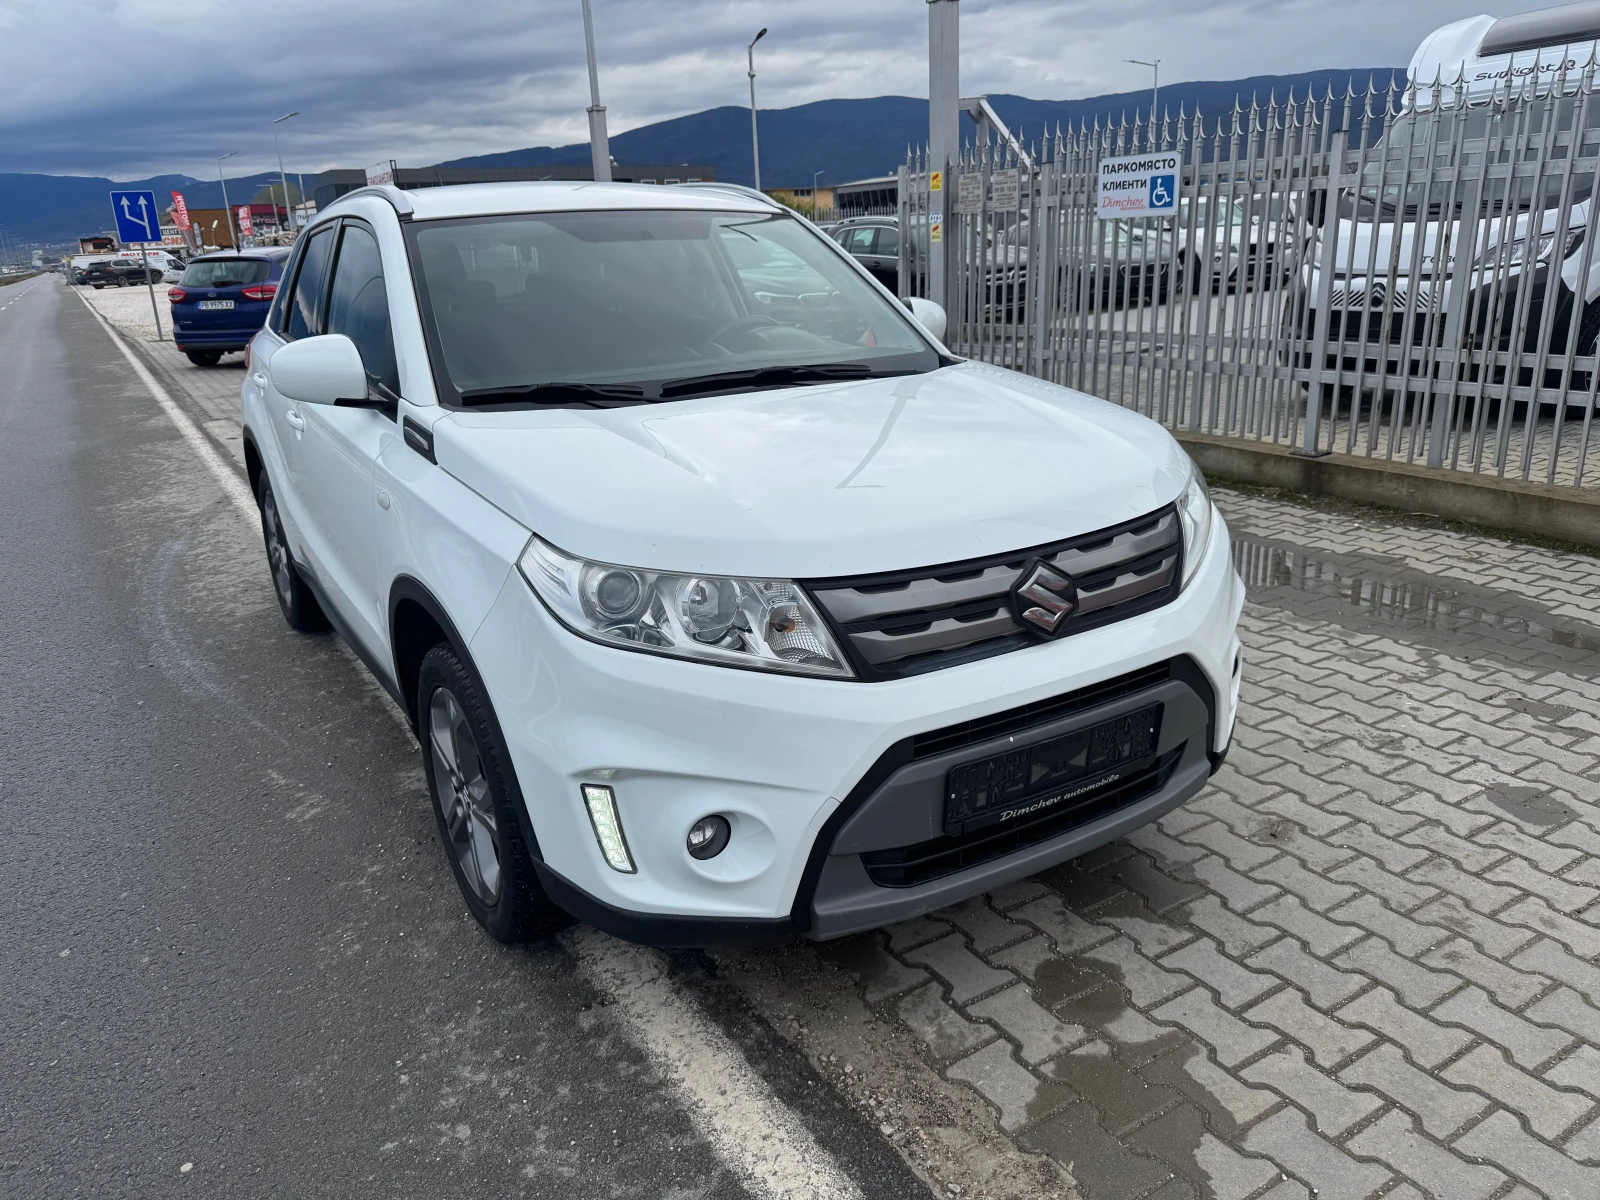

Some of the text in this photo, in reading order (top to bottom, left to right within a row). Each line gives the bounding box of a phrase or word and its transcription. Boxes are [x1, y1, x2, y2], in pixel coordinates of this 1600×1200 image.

[1102, 158, 1176, 175] ПАРКОМЯСТО
[1102, 179, 1147, 191] КЛИЕНТИ
[1102, 195, 1144, 208] Dimchev
[1000, 773, 1120, 822] Dimchev automobile
